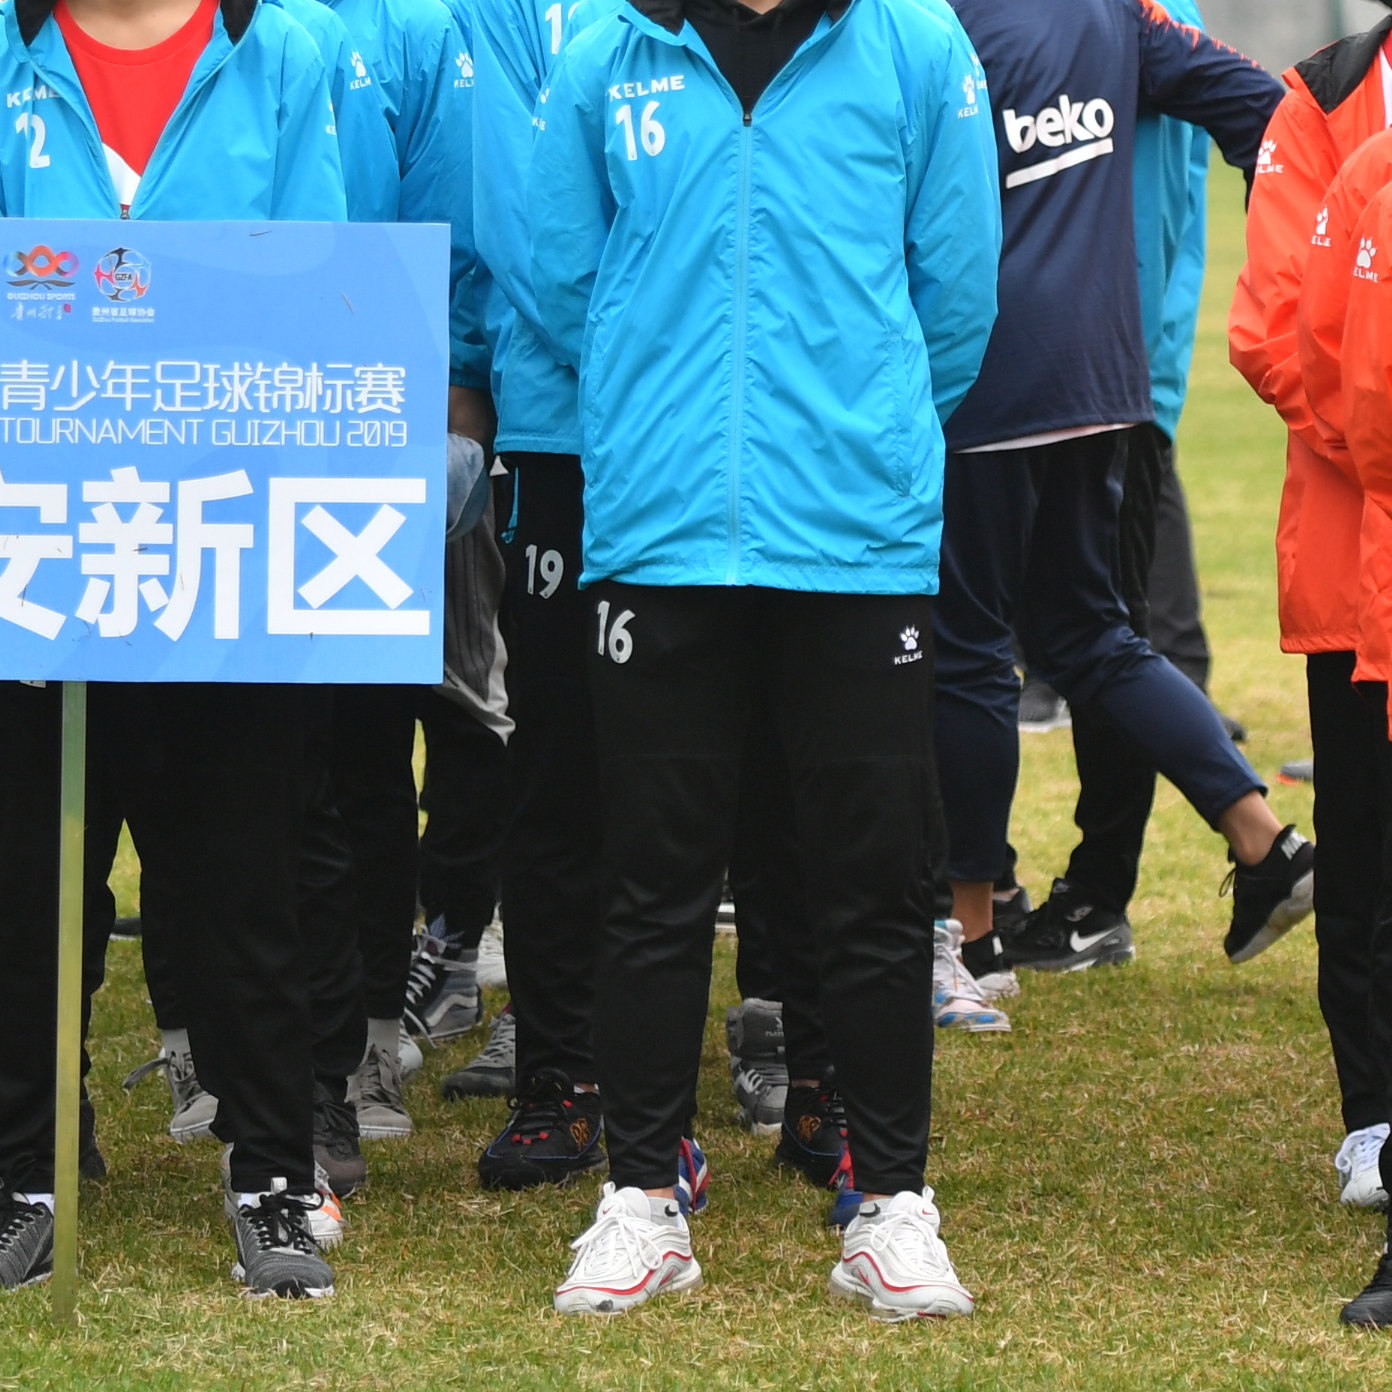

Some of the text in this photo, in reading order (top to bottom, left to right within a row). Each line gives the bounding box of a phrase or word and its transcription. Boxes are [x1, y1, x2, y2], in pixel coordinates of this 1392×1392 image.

[608, 74, 685, 102] KELME
[615, 100, 666, 162] 16
[1002, 94, 1115, 154] beko
[7, 293, 76, 301] GUIZHOU SPORTS
[211, 419, 341, 447] GUIZHOU
[347, 420, 407, 447] 2019
[525, 543, 565, 599] 19
[597, 600, 636, 664] 16
